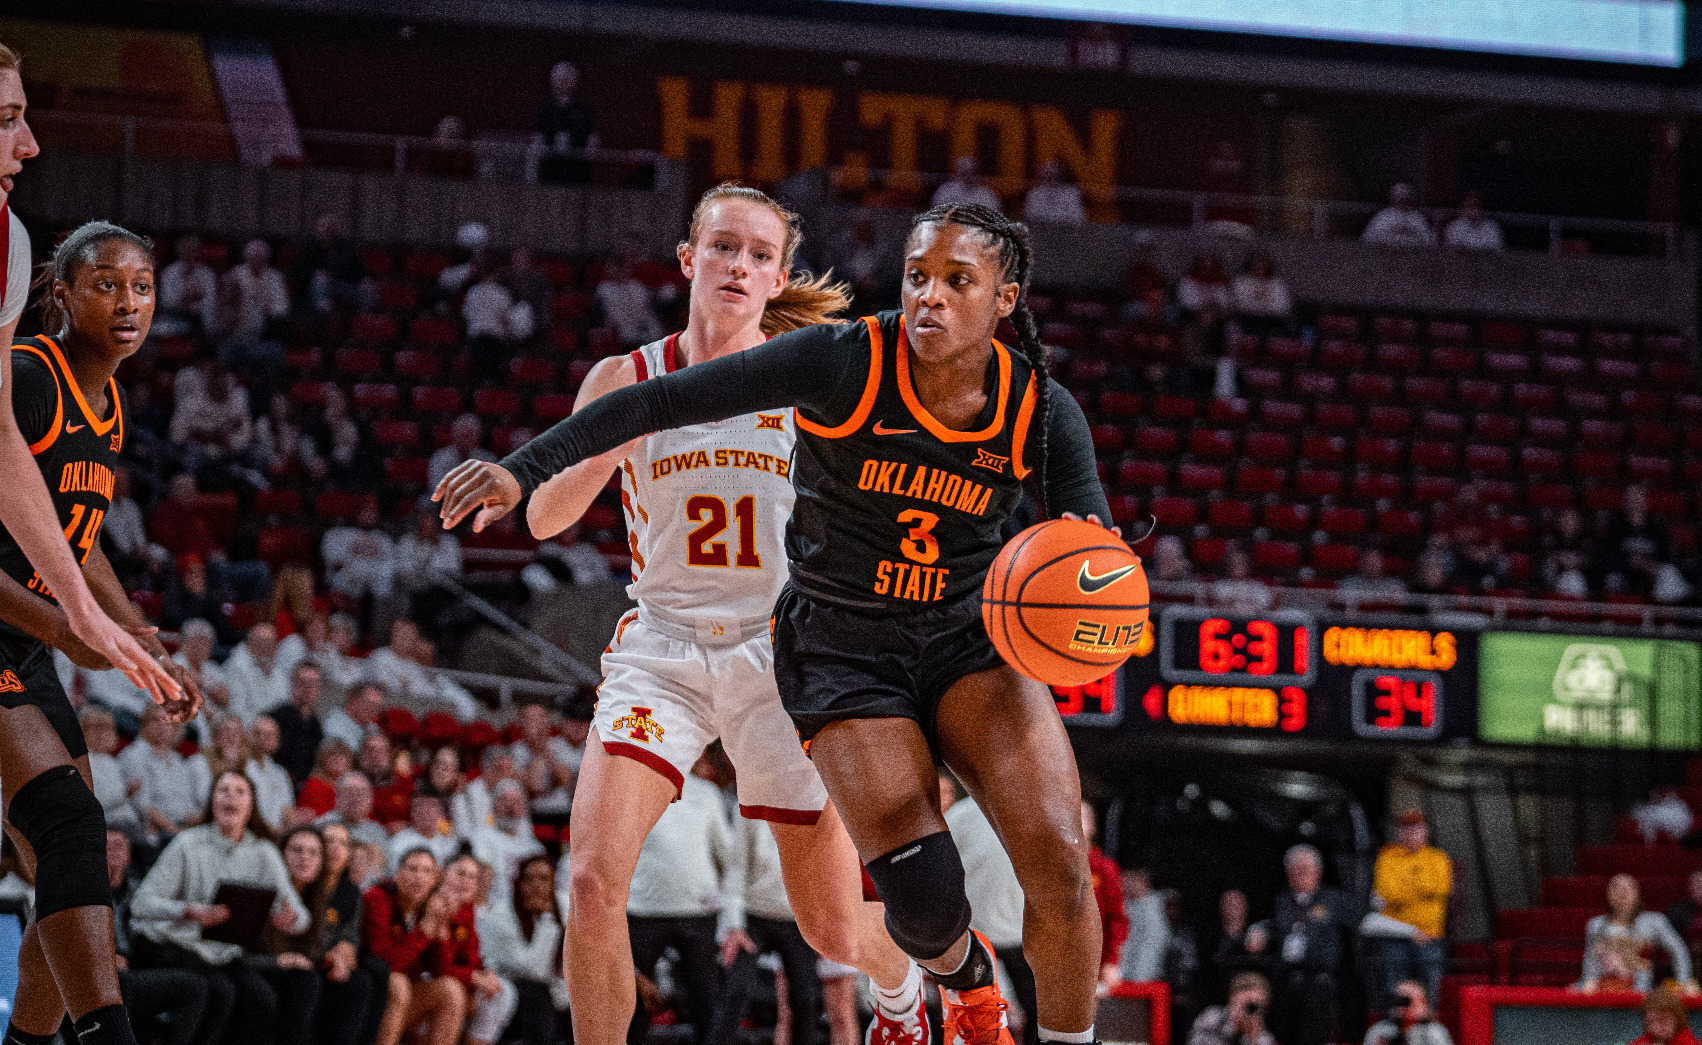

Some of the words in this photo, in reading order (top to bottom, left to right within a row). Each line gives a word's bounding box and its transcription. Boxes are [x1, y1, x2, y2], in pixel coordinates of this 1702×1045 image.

[657, 76, 1127, 224] HILTON
[652, 450, 711, 482] IOWA
[714, 449, 789, 479] STATE
[857, 459, 993, 516] OKLAHOMA
[63, 503, 104, 565] 14
[685, 494, 762, 569] 21
[896, 508, 940, 565] 3
[874, 559, 949, 602] STATE
[1073, 619, 1145, 647] ELITE
[1199, 618, 1309, 676] 6:31
[612, 715, 665, 743] STATE
[1280, 686, 1307, 732] 3
[1375, 675, 1435, 729] 34
